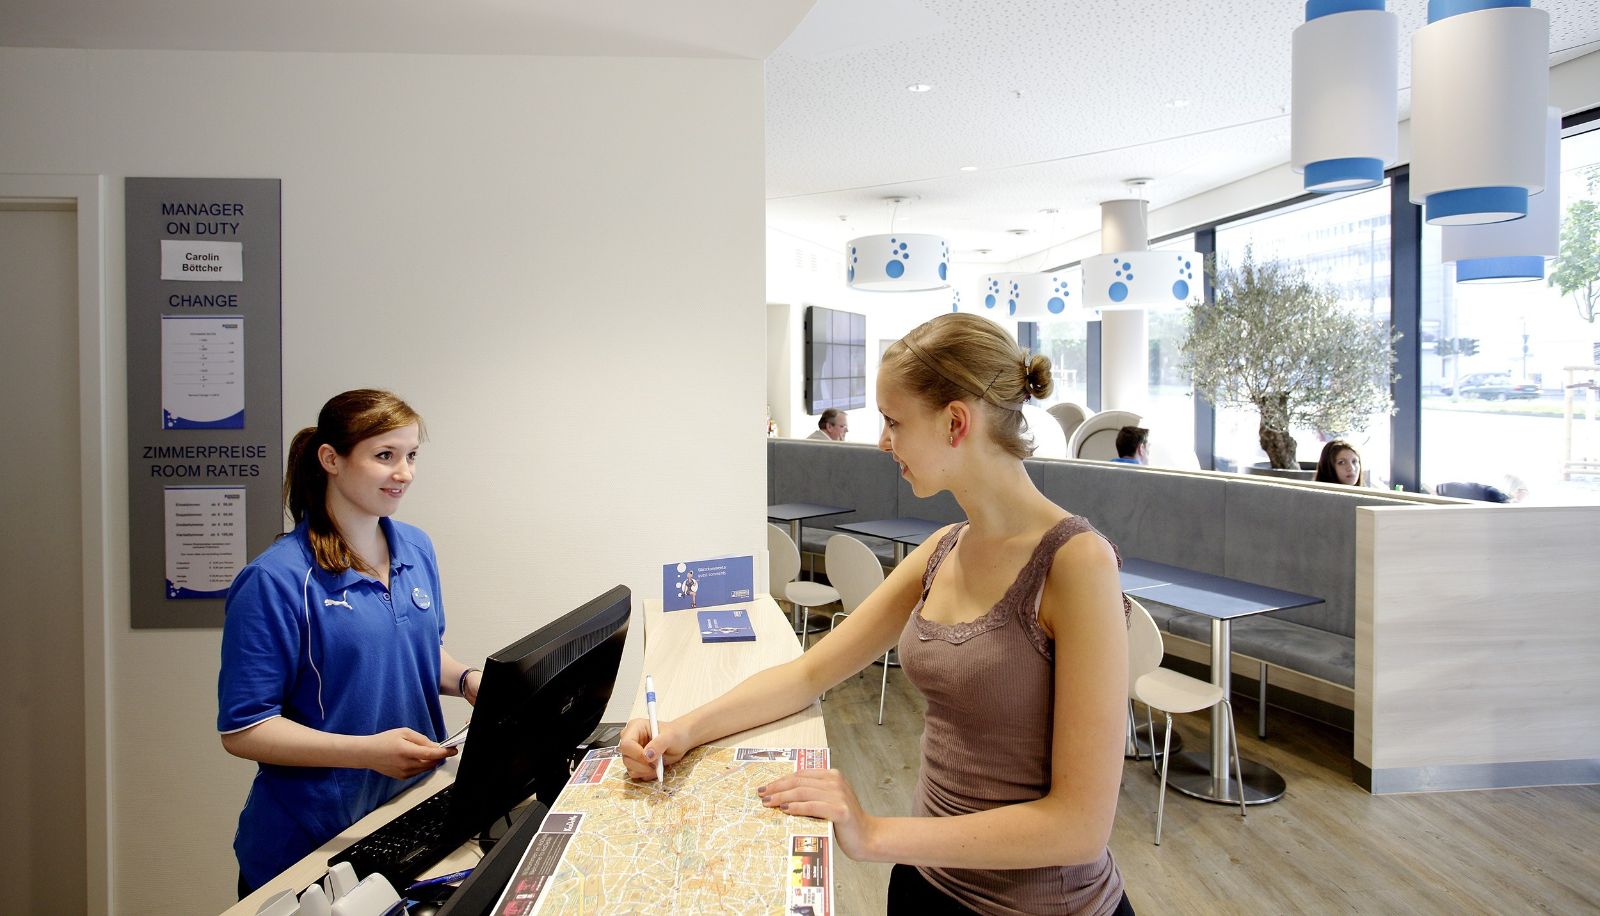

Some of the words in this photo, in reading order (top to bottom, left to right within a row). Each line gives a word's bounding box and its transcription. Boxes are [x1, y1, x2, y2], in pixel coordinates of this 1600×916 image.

[162, 203, 244, 216] MANAGER
[167, 222, 190, 235] ON
[196, 222, 240, 235] DUTY
[185, 252, 220, 261] Carolin
[182, 263, 223, 272] Böttcher
[169, 294, 238, 308] CHANGE
[143, 446, 267, 459] ZIMMERPREISE
[151, 464, 201, 478] ROOM
[206, 464, 260, 477] RATES
